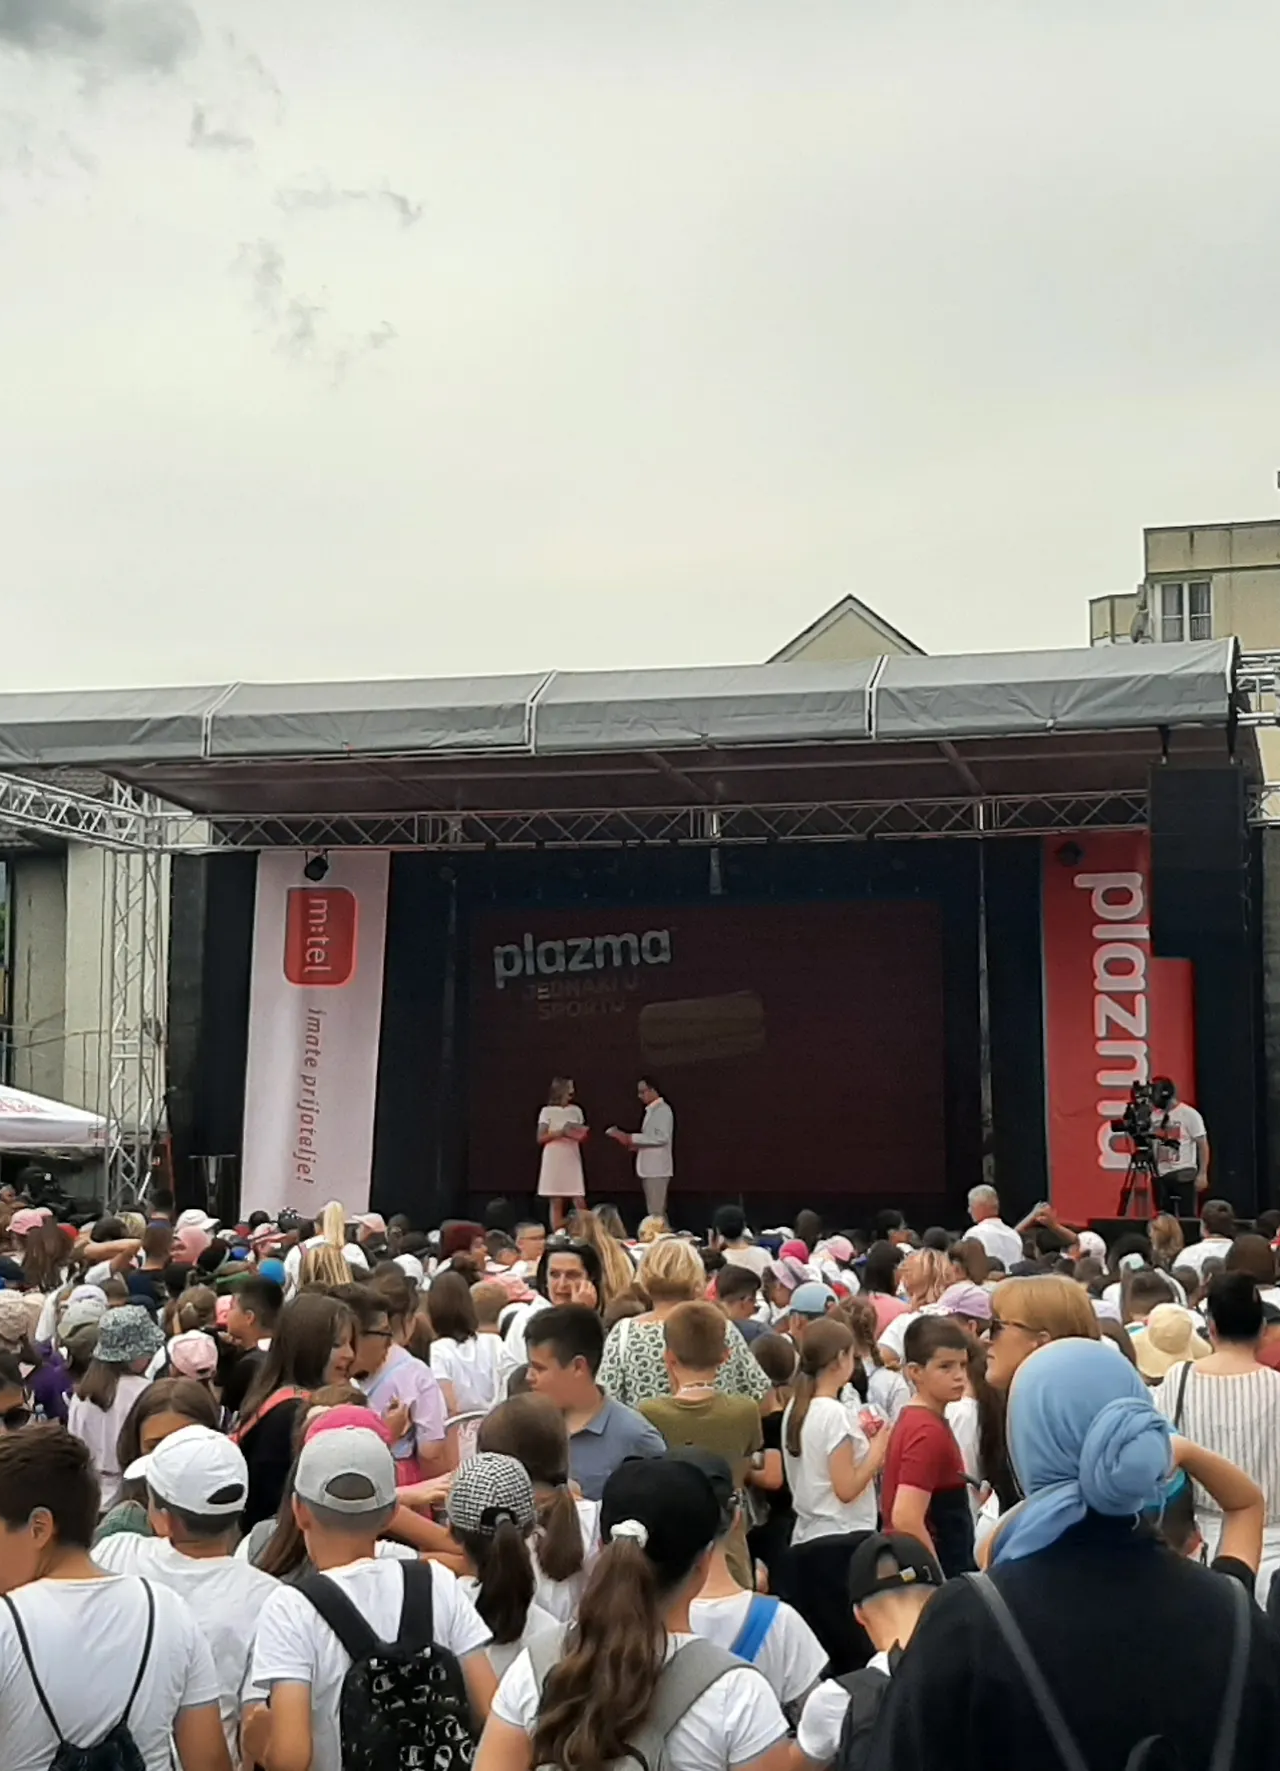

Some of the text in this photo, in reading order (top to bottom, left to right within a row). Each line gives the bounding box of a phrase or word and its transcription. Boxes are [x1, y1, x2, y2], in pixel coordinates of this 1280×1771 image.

[303, 897, 333, 974] m:tel
[492, 928, 672, 990] plazma
[293, 1007, 328, 1185] imate prijatelje!
